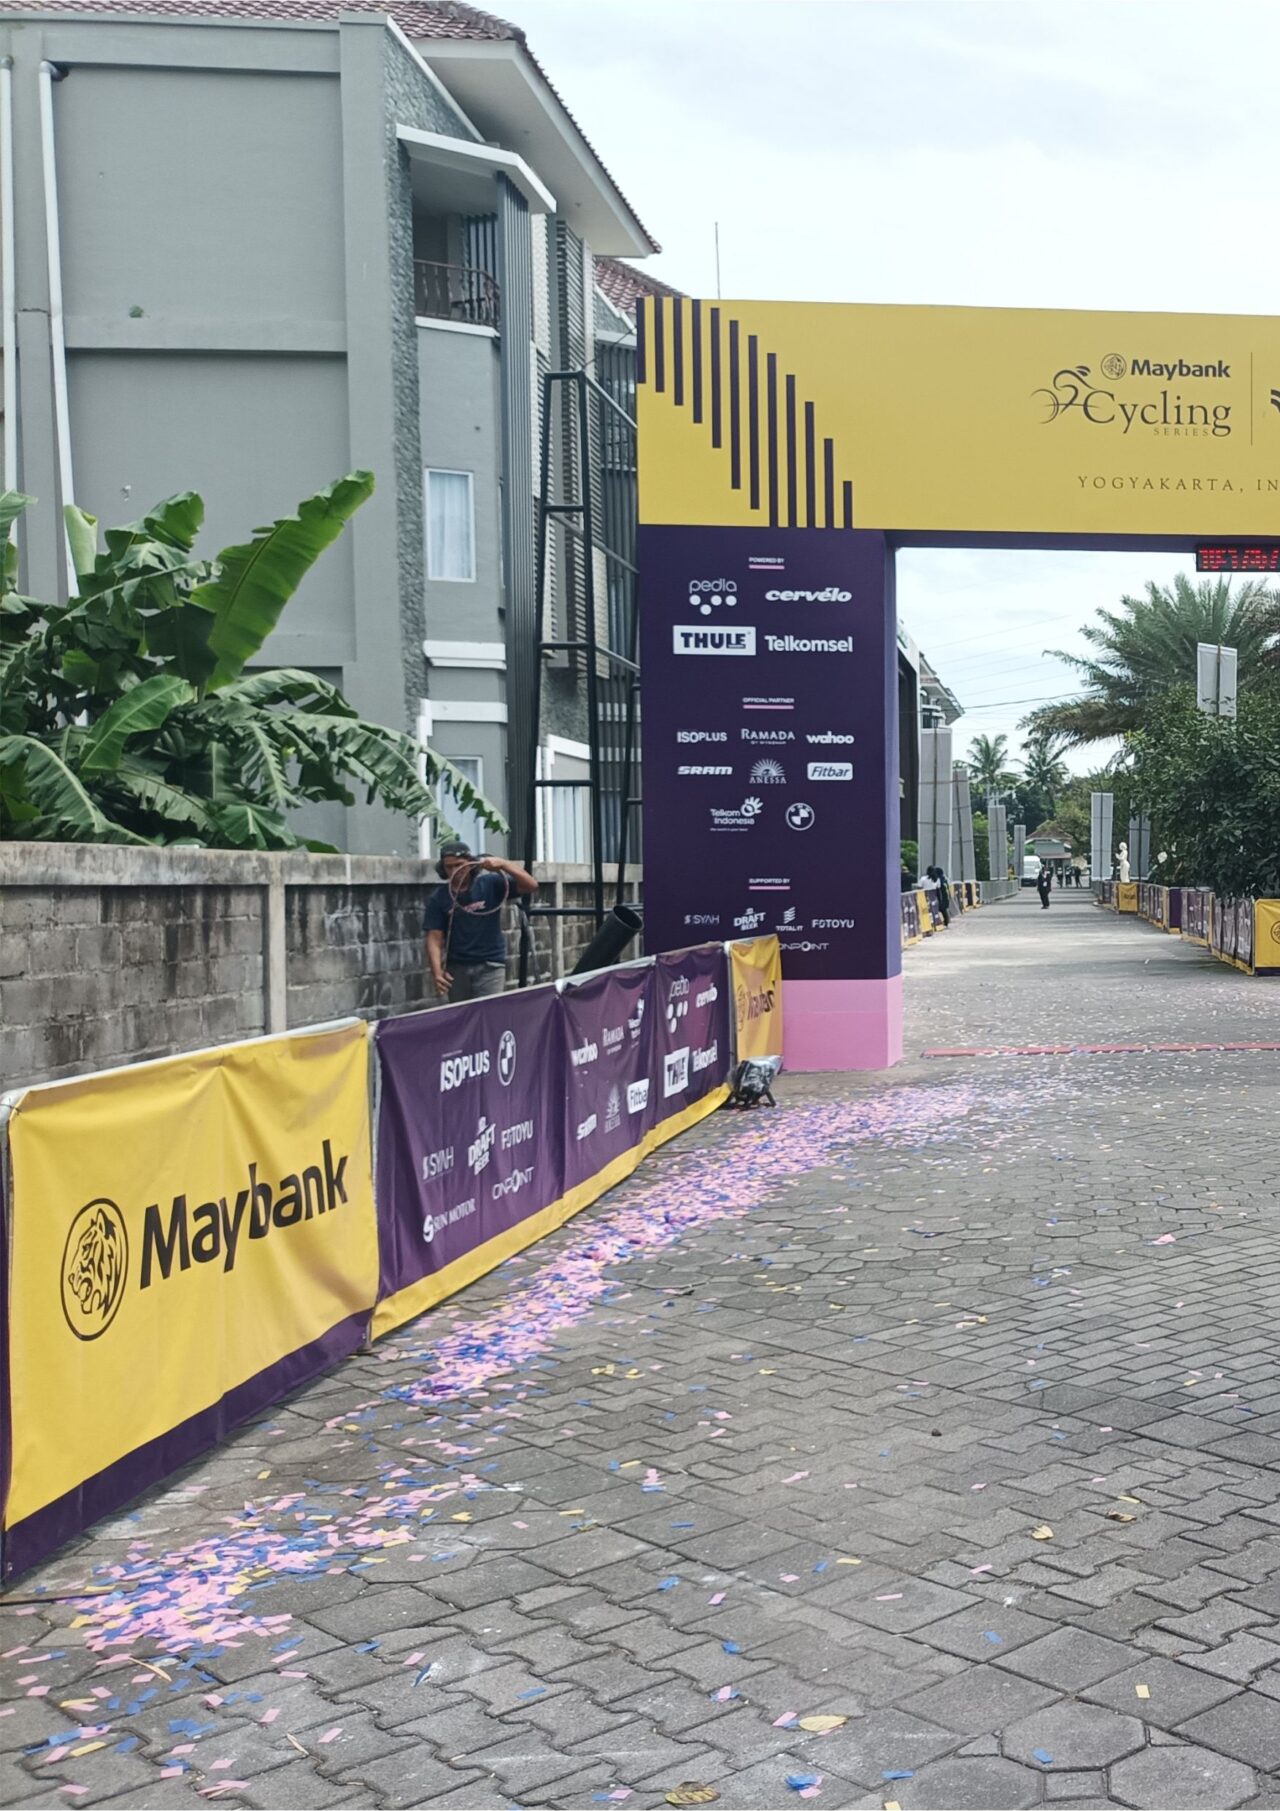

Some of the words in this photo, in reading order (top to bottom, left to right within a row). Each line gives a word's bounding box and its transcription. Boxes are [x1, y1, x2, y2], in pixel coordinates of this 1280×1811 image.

[1130, 358, 1231, 381] Maybank
[1083, 389, 1232, 438] Cycling
[1153, 427, 1210, 437] SERIES
[1077, 475, 1245, 493] YOGYAKARTA,
[765, 587, 852, 602] cervélo
[680, 632, 747, 649] THULE
[764, 635, 853, 652] Telkomsel
[677, 731, 728, 743] ISOPLUS
[741, 728, 795, 740] RAMADA
[806, 731, 855, 744] wahoo
[677, 766, 733, 775] SRAM
[811, 766, 850, 778] Fitbar
[710, 808, 741, 817] Telkom
[714, 817, 755, 825] Indonesia
[734, 912, 766, 927] DRAFT
[440, 1050, 490, 1092] ISOPLUS
[139, 1139, 349, 1290] Maybank
